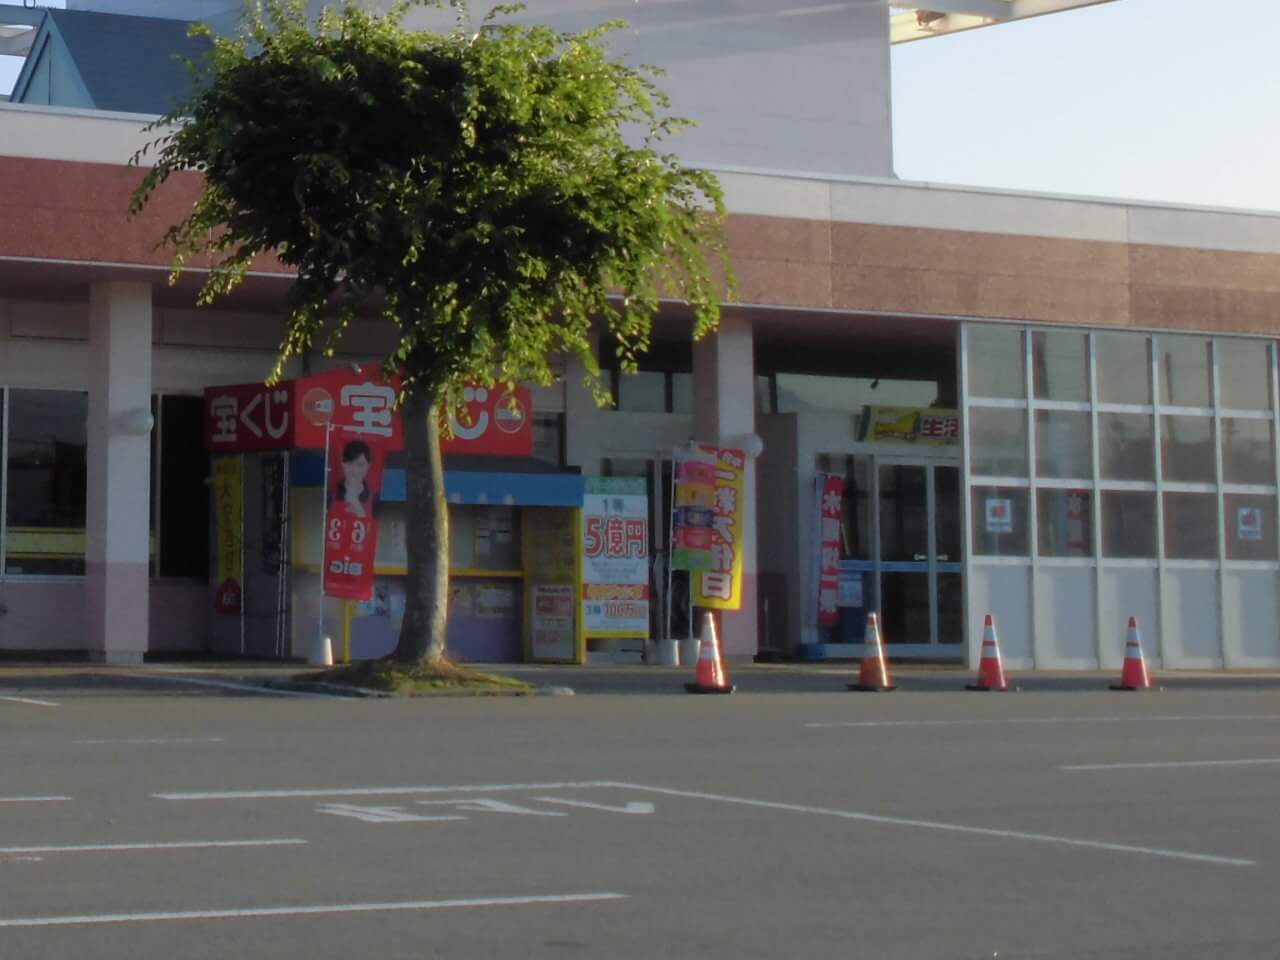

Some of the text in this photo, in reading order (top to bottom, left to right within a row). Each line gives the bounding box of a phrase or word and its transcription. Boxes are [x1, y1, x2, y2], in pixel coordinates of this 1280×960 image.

[210, 393, 290, 443] 宝くじ
[584, 515, 648, 560] 5億円
